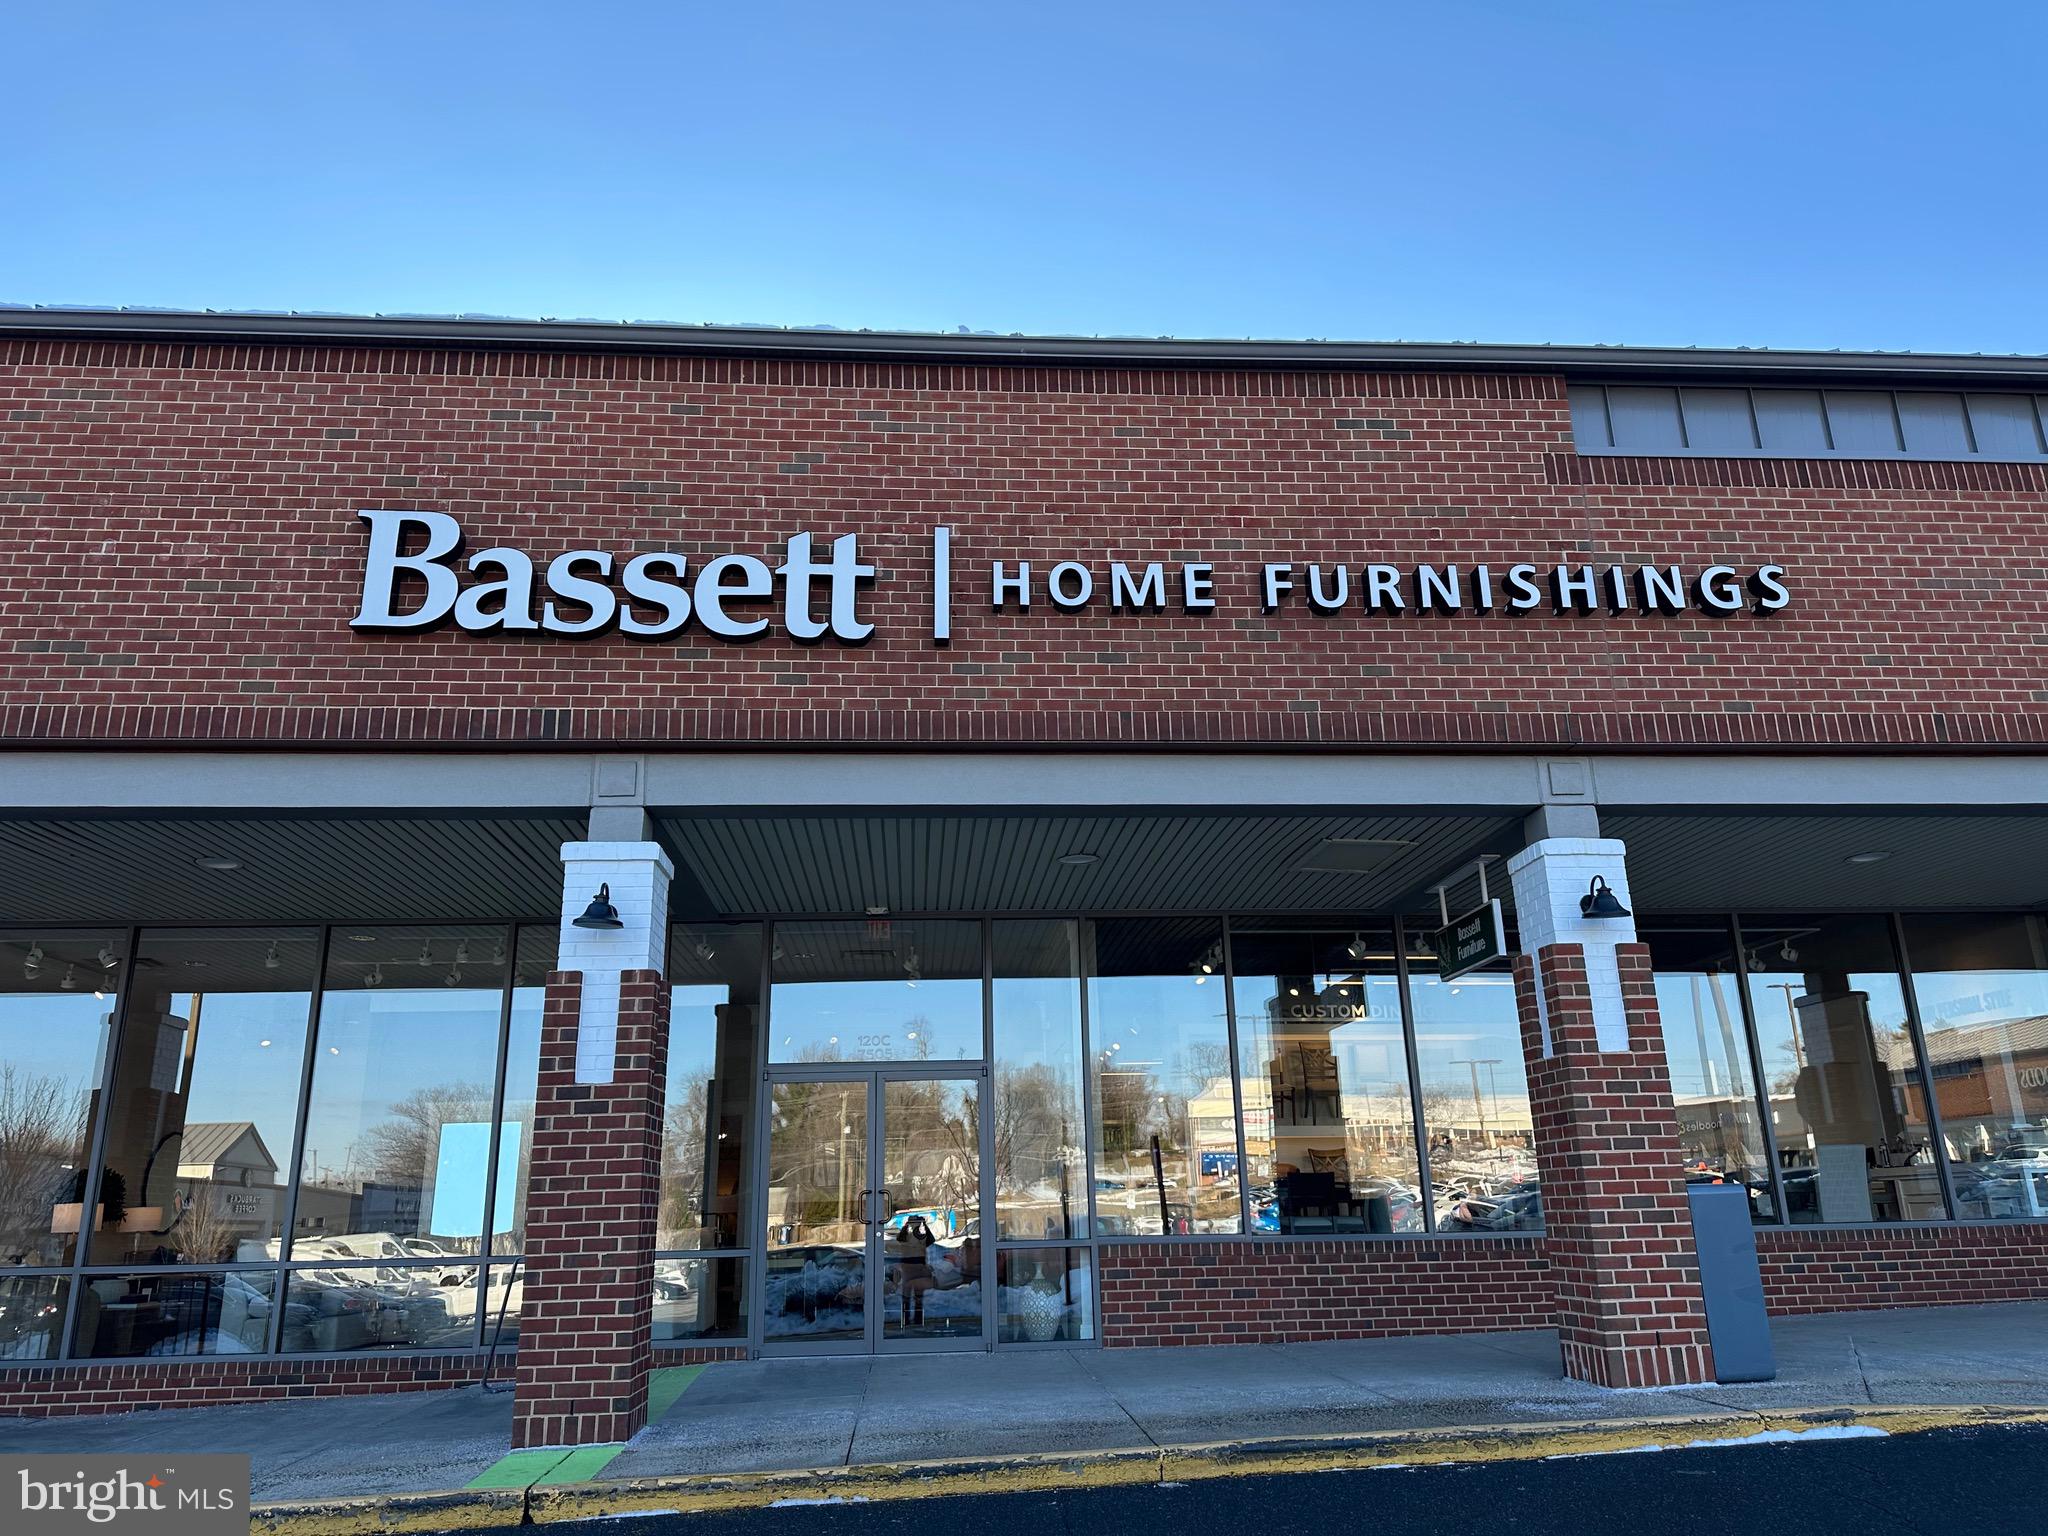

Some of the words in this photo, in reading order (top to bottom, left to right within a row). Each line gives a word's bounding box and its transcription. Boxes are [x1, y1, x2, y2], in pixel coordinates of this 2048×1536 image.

[348, 508, 876, 645] Bassett
[990, 560, 1216, 612] HOME
[1262, 561, 1791, 615] FURNISHINGS
[1457, 917, 1481, 940] Bassett
[1457, 937, 1486, 960] Furniture
[1290, 1004, 1365, 1018] CUSTOM
